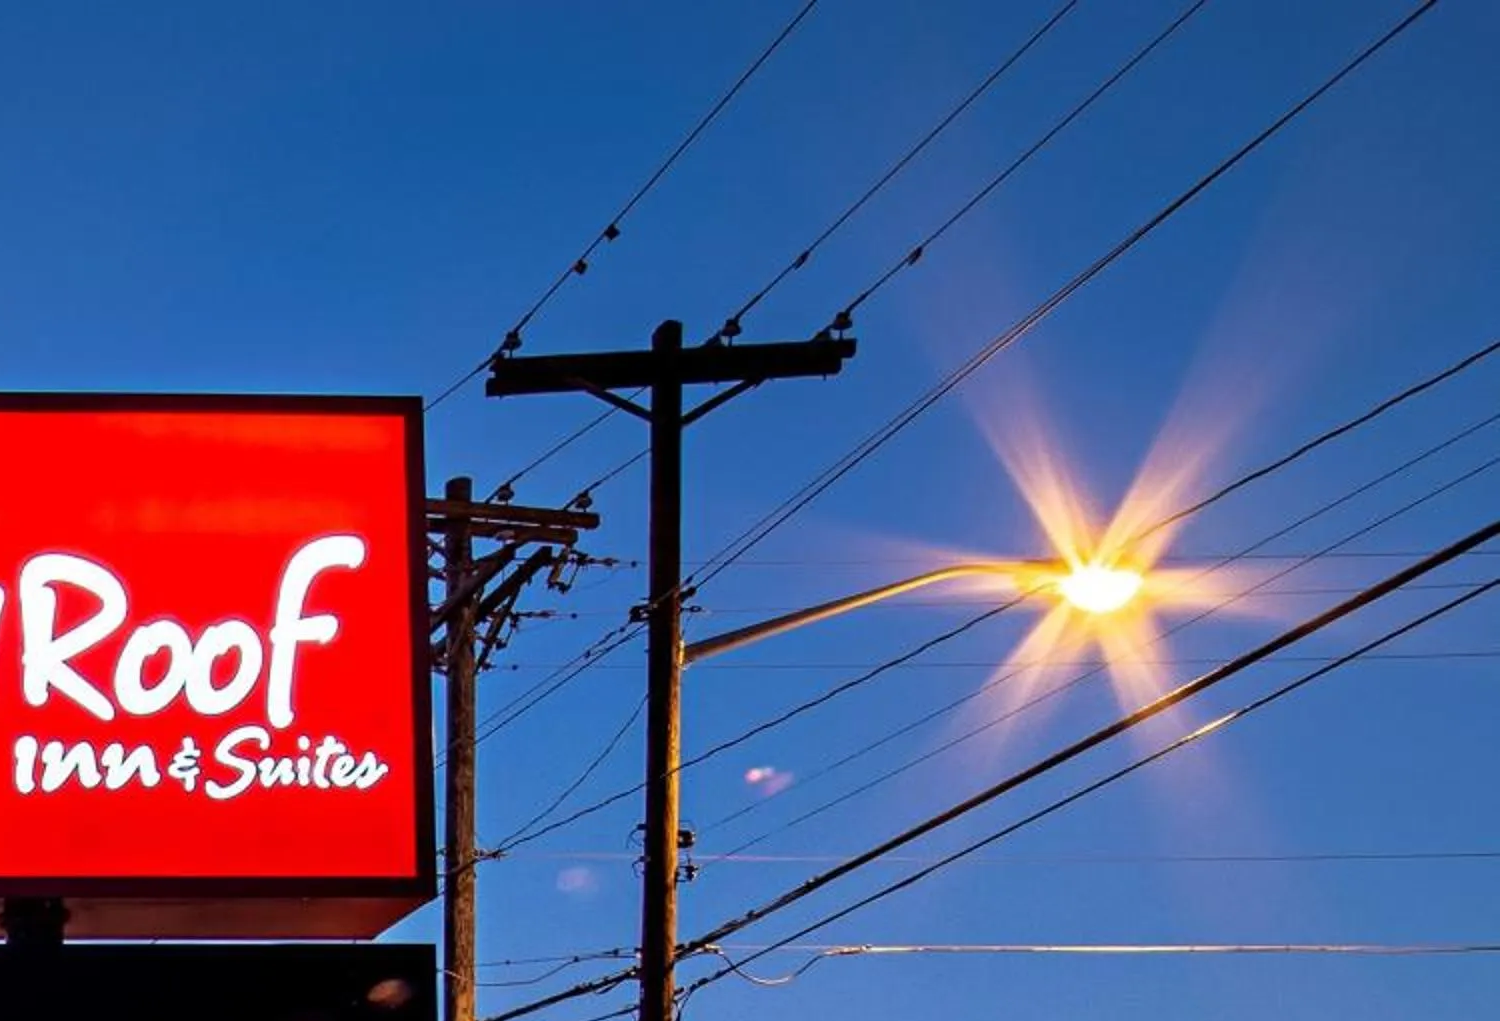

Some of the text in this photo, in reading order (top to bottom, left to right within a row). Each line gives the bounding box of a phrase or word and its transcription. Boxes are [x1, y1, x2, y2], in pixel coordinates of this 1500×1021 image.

[18, 534, 366, 729] Roof
[13, 725, 390, 801] Inn & Suites
